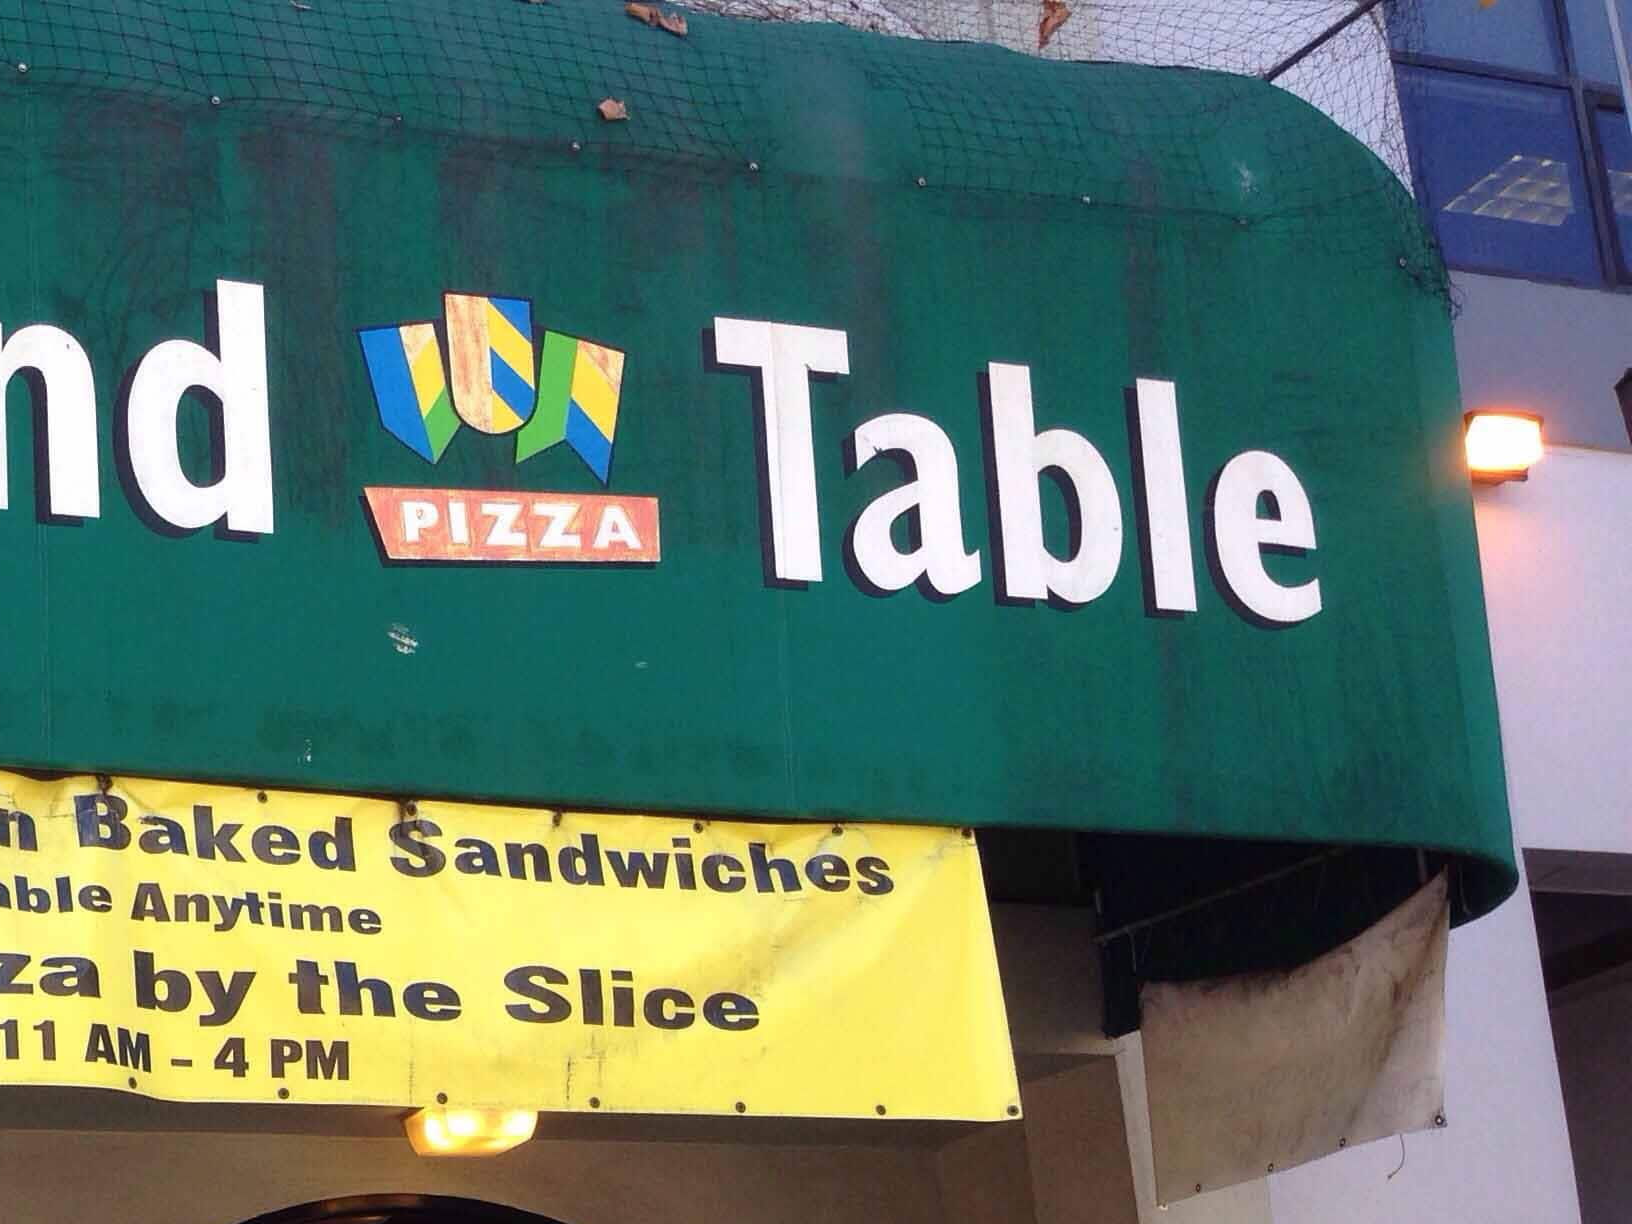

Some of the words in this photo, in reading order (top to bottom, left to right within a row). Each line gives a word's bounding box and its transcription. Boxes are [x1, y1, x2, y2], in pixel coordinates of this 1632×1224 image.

[710, 316, 1323, 624] Table
[402, 500, 647, 550] PIZZA
[74, 793, 356, 872] Baked
[389, 819, 895, 895] Sandwiches
[131, 882, 382, 935] Anytime
[134, 950, 256, 1027] by
[288, 959, 462, 1022] the
[504, 965, 761, 1031] Slice
[85, 1023, 152, 1073] AM
[213, 1037, 250, 1079] 4
[270, 1038, 350, 1081] PM
